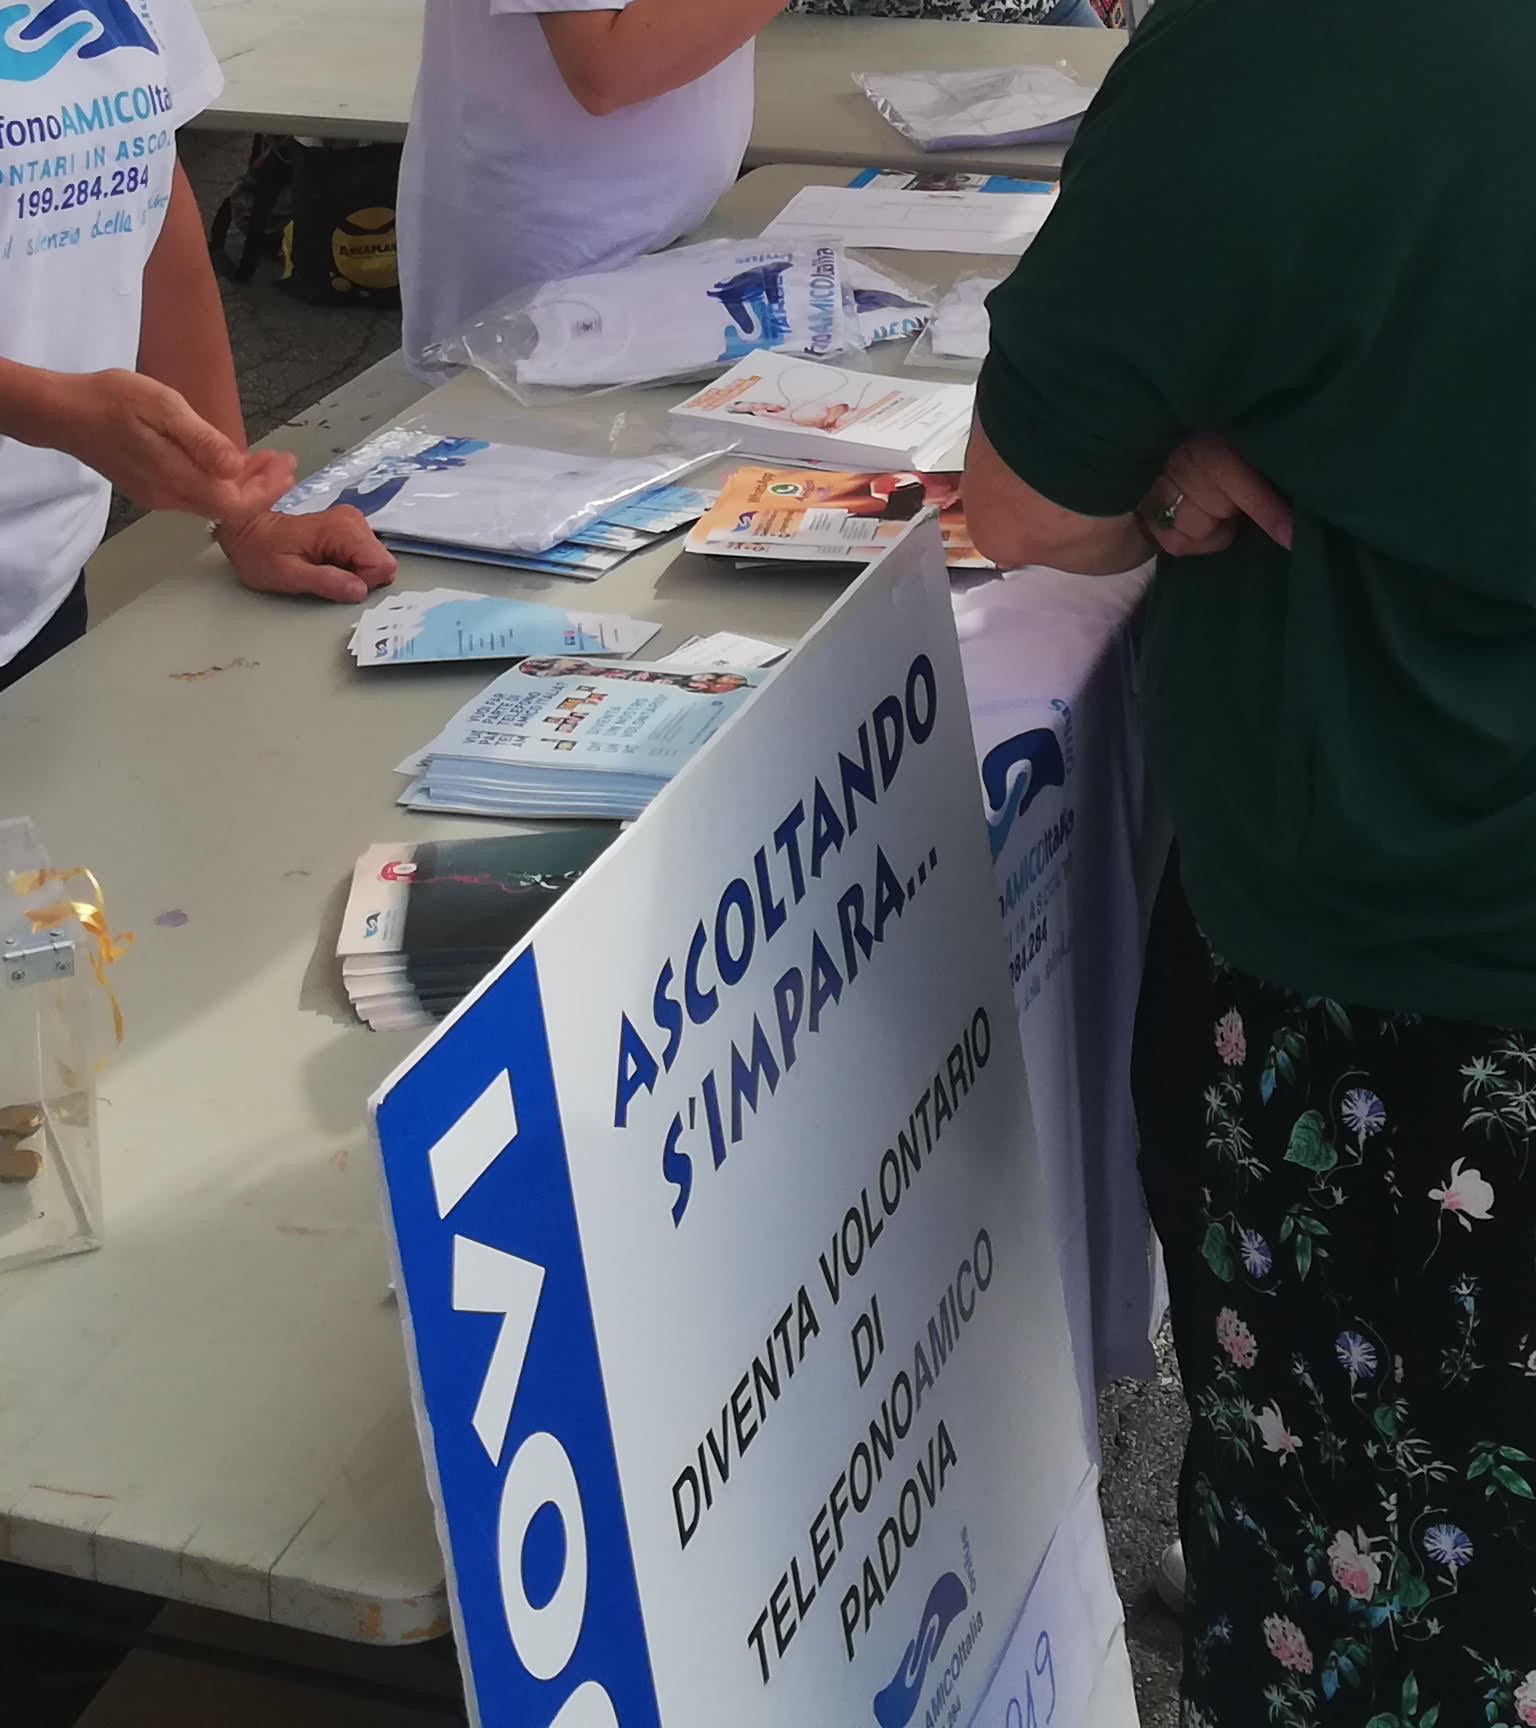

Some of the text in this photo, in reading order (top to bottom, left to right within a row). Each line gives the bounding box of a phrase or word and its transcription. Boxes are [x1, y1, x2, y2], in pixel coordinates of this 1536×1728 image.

[16, 164, 150, 220] 199.284.284
[84, 145, 107, 171] IN
[114, 130, 173, 162] ASCO
[90, 209, 134, 240] della
[496, 690, 542, 726] TELEFONO
[613, 652, 938, 1128] ASCOLTANDO
[662, 841, 939, 1229] S'IMPARA...
[670, 1004, 993, 1550] DIVENTA VOLONTARIO
[851, 1294, 886, 1389] DI
[747, 1227, 994, 1685] TELEFONOAMICO
[840, 1418, 958, 1663] PADOVA
